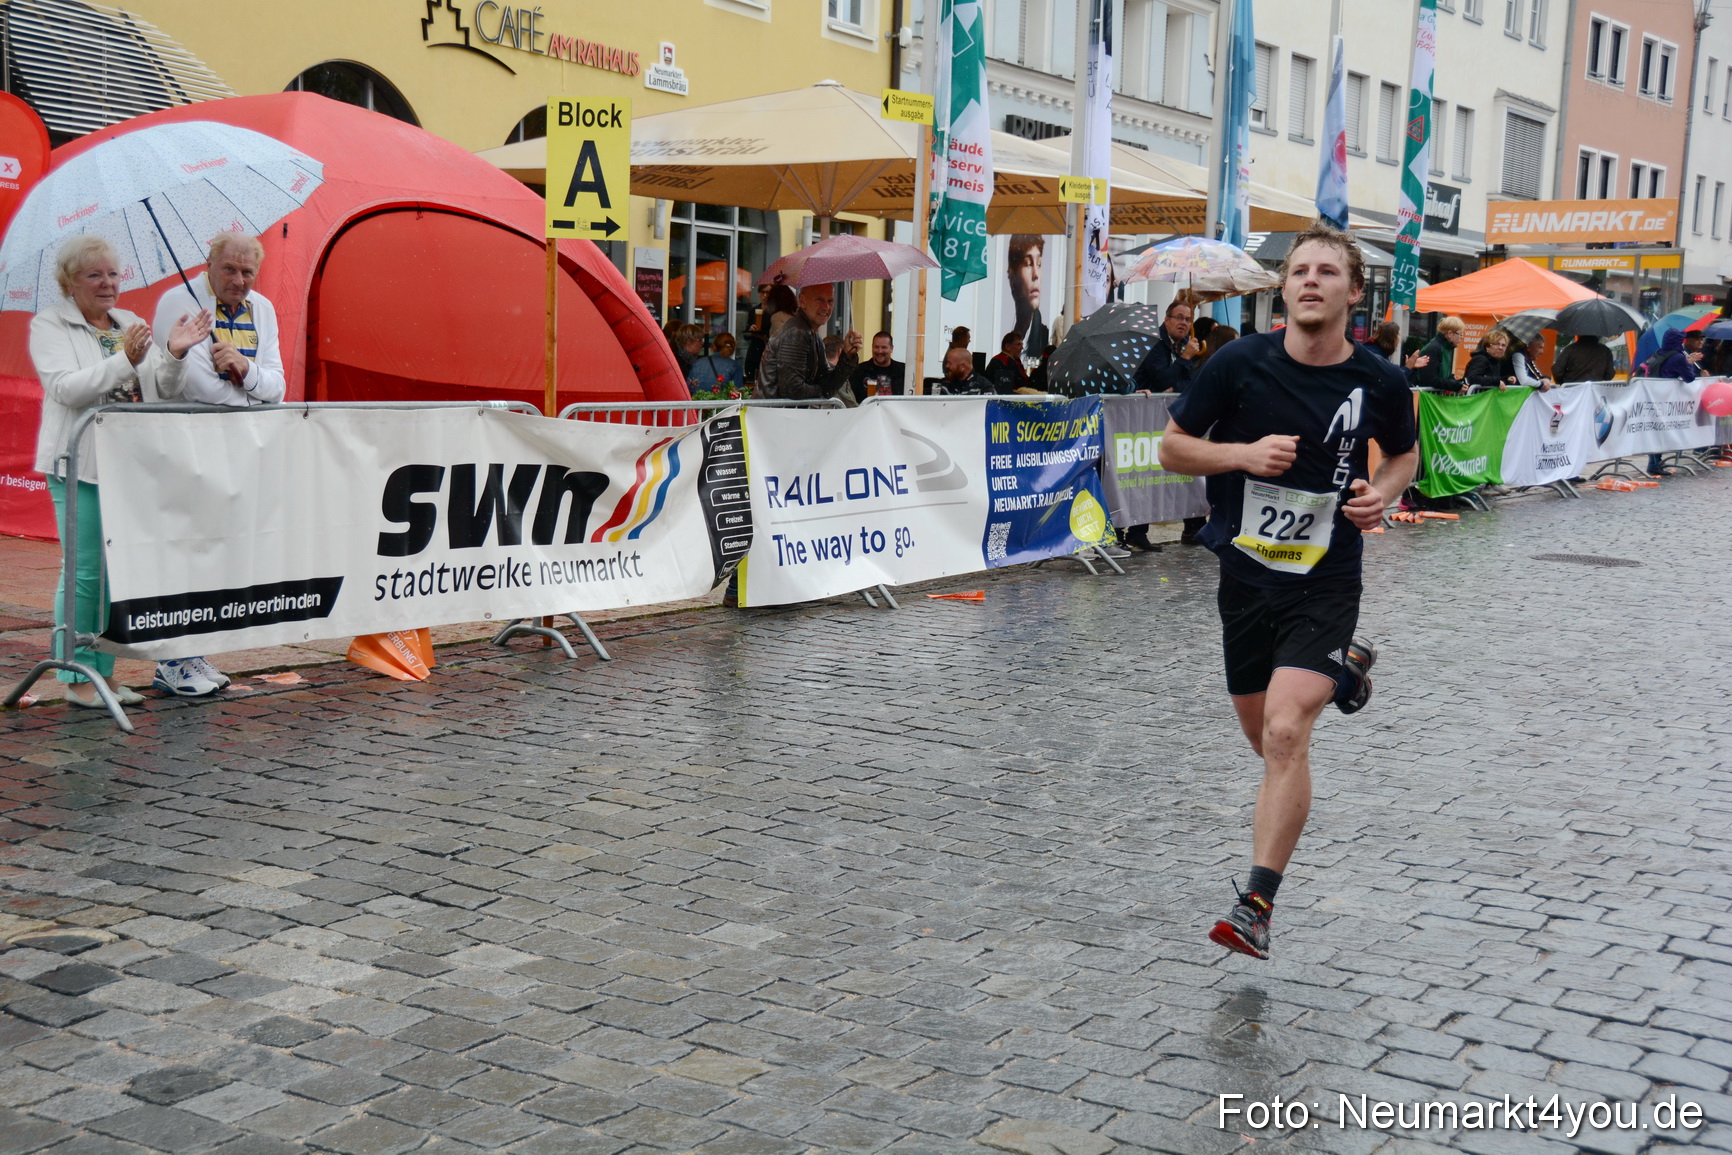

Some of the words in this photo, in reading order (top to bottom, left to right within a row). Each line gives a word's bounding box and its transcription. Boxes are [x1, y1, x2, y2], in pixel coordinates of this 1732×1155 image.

[475, 0, 545, 54] CAFÉ
[547, 32, 575, 59] AM
[577, 38, 641, 77] RATHAUS
[654, 66, 683, 79] Neumarkter
[648, 74, 687, 92] Lammsbräu
[891, 94, 933, 109] Startnummern-
[558, 101, 623, 128] Block
[900, 109, 924, 121] ausgabe
[563, 139, 612, 209] A
[1074, 191, 1092, 202] ausgab
[1491, 210, 1667, 234] RUNMARKT.DE
[1560, 258, 1629, 268] RUNMARKT.DE
[990, 421, 1010, 443] WIR
[1016, 420, 1070, 442] SUCHEN
[990, 454, 1013, 470] FREIE
[1016, 443, 1100, 468] AUSBILDUNGSPLÄTZE
[715, 467, 738, 476] Wasser
[6, 474, 47, 491] besiegen
[764, 464, 909, 509] RAIL.ONE
[991, 475, 1018, 491] UNTER
[721, 492, 741, 501] Wärme
[725, 514, 744, 524] Freizeit
[1258, 505, 1315, 541] 222
[724, 539, 749, 549] Stadtbusse
[772, 533, 808, 567] The
[811, 534, 853, 566] way
[860, 526, 887, 554] to
[895, 526, 915, 558] go.
[1255, 542, 1303, 561] Thomas
[374, 557, 532, 602] stadtwerke
[539, 550, 644, 586] neumarkt
[128, 606, 217, 631] Leistungen,
[220, 601, 246, 619] die
[248, 592, 321, 616] verbinden
